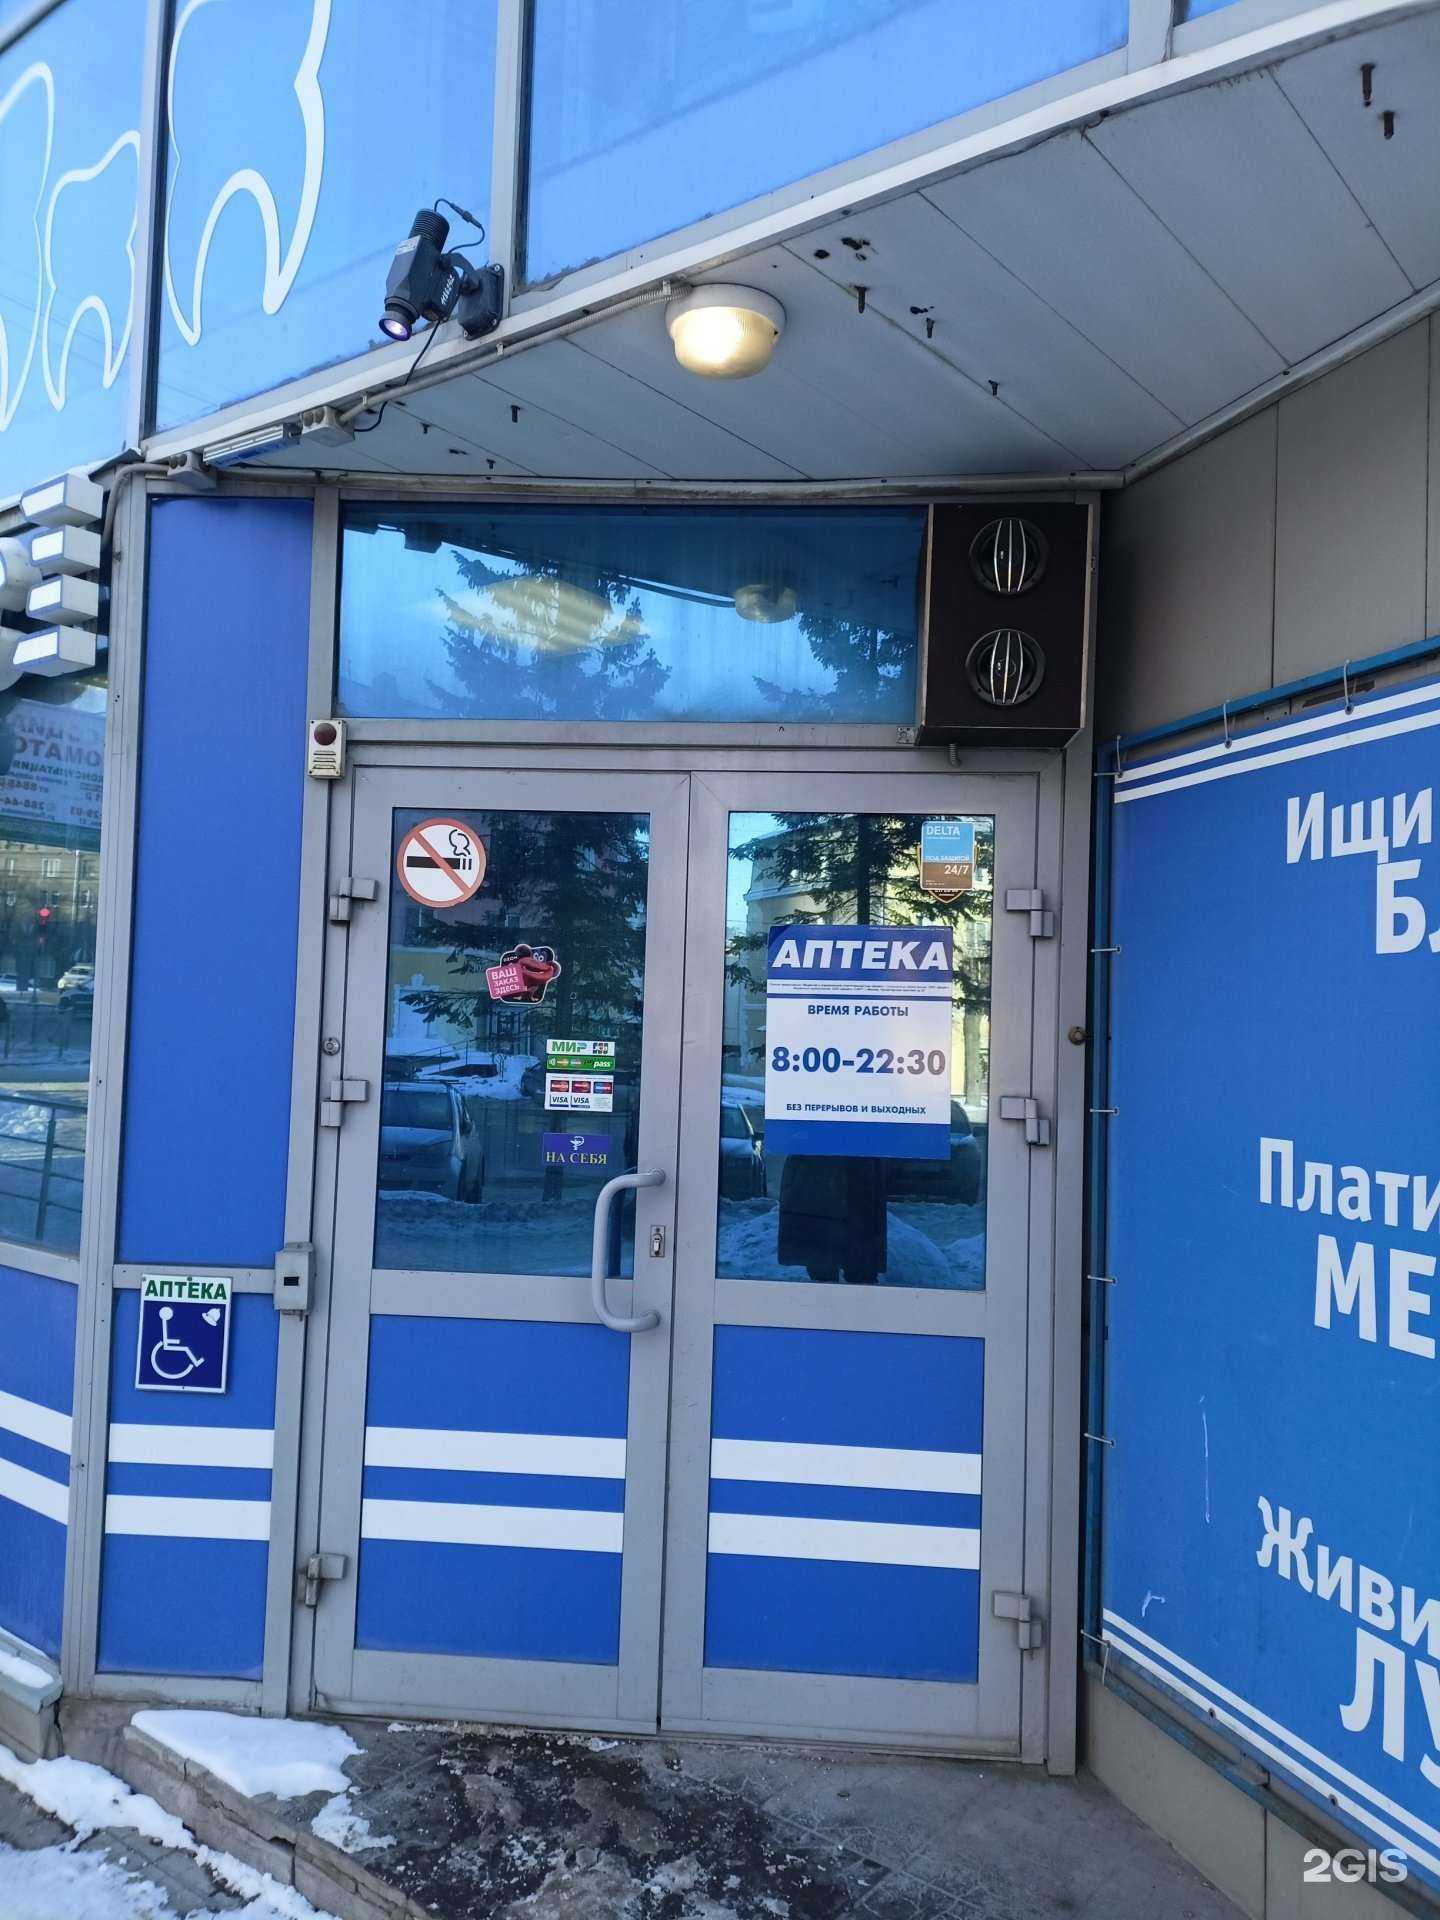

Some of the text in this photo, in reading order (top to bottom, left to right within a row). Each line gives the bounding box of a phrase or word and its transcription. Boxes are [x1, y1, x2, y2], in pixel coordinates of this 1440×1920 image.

[926, 825, 960, 837] DELTA
[1287, 787, 1432, 864] Ищи
[944, 864, 969, 877] 24/7
[771, 939, 949, 971] АПТЕКА
[491, 968, 517, 980] ВАШ
[493, 977, 519, 986] ЗАКАЗ
[495, 984, 520, 995] ЗДЕСЬ
[807, 1004, 909, 1017] ВРЕМЯ РАБОТЫ
[551, 1041, 587, 1053] МИР
[771, 1046, 946, 1076] 8:00-22:30
[786, 1103, 926, 1115] БЕЗ ПЕРЕРЫВОВ И ВЫХОДНЫХ
[546, 1151, 607, 1165] НА СЕБЯ
[1260, 1137, 1440, 1233] Плати
[145, 1280, 227, 1300] АПТЕКА
[1314, 1234, 1437, 1360] МЕ
[1256, 1495, 1440, 1660] Живи
